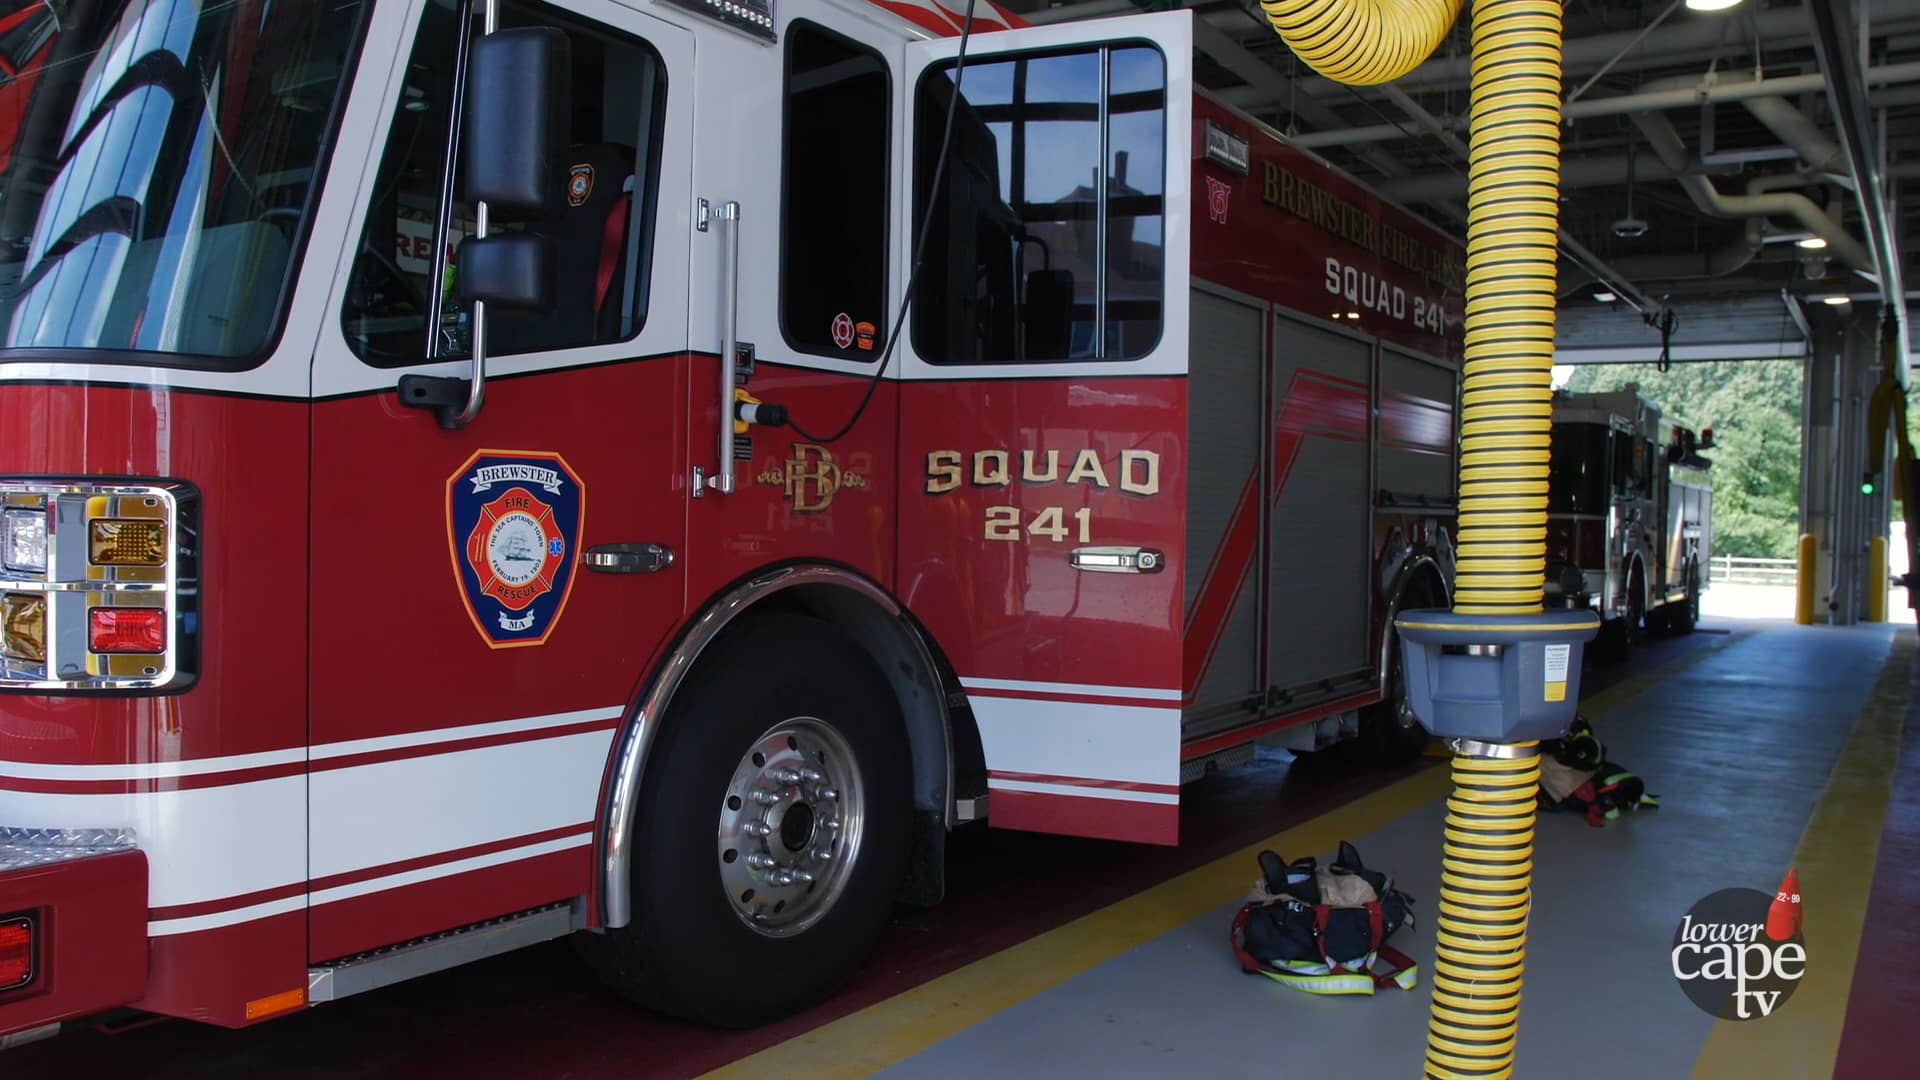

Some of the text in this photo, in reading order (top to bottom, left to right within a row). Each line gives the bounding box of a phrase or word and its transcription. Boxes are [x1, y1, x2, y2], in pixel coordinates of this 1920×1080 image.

[1263, 161, 1375, 250] BREWSTER
[1382, 224, 1420, 273] FIRE
[1325, 257, 1405, 320] SQUAD
[1413, 295, 1444, 336] 241
[481, 466, 555, 484] BREWSTER
[925, 448, 1160, 497] SQUAD
[504, 497, 530, 509] FIRE
[983, 506, 1091, 543] 241
[534, 526, 544, 548] TOWN
[497, 586, 537, 600] RESCUE
[508, 618, 526, 629] MA
